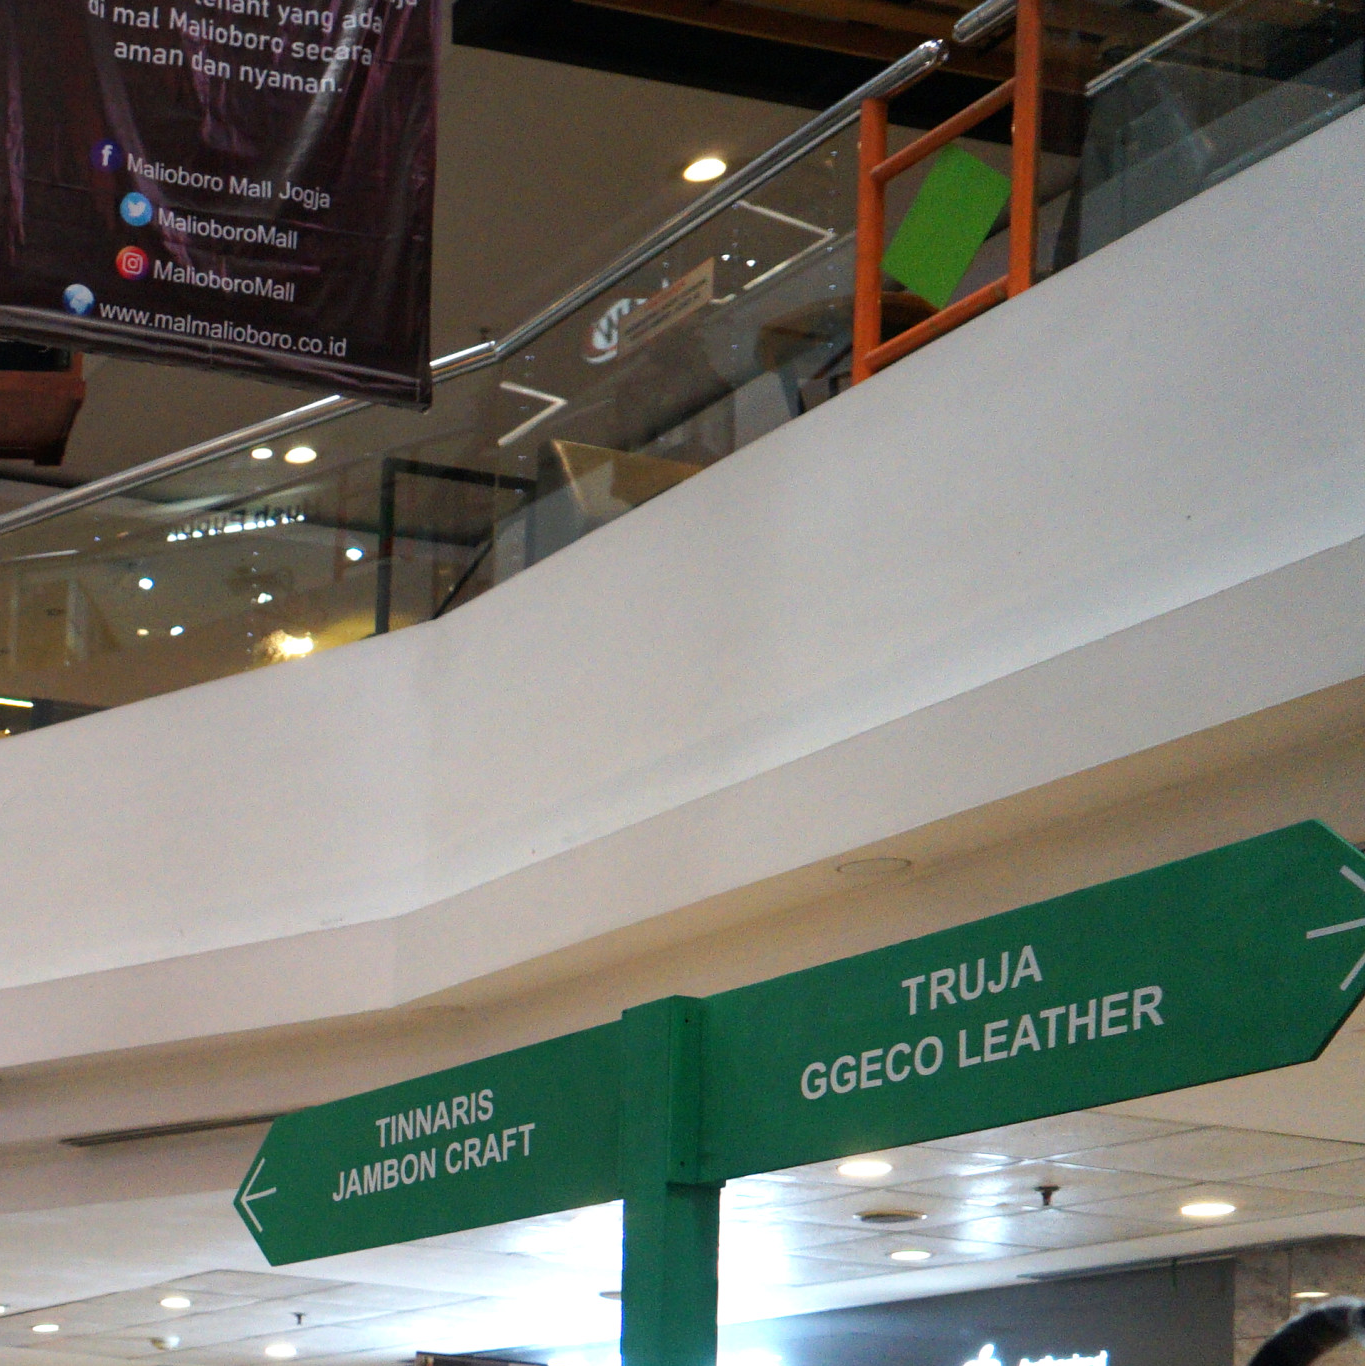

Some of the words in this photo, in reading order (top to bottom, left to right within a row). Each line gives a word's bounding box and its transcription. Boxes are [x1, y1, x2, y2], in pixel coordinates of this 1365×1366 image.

[88, 0, 105, 18] di
[113, 4, 159, 29] mal
[169, 7, 284, 54] Malioboro
[291, 40, 373, 66] secara
[277, 4, 334, 33] yang
[342, 7, 384, 34] ada
[114, 42, 184, 67] aman
[191, 52, 231, 80] dan
[239, 65, 344, 95] nyaman.
[127, 153, 223, 192] Malioboro
[229, 175, 272, 200] Mall
[278, 181, 332, 211] Jogja
[157, 208, 299, 251] MalioboroMall
[153, 259, 296, 303] MalioboroMall
[99, 302, 347, 357] www.malmalioboro.co.id
[901, 945, 1042, 1017] TRUJA
[800, 1036, 944, 1101] GGECO
[957, 985, 1165, 1069] LEATHER
[375, 1089, 495, 1149] TINNARIS
[332, 1147, 438, 1204] JAMBON
[444, 1123, 536, 1176] CRAFT
